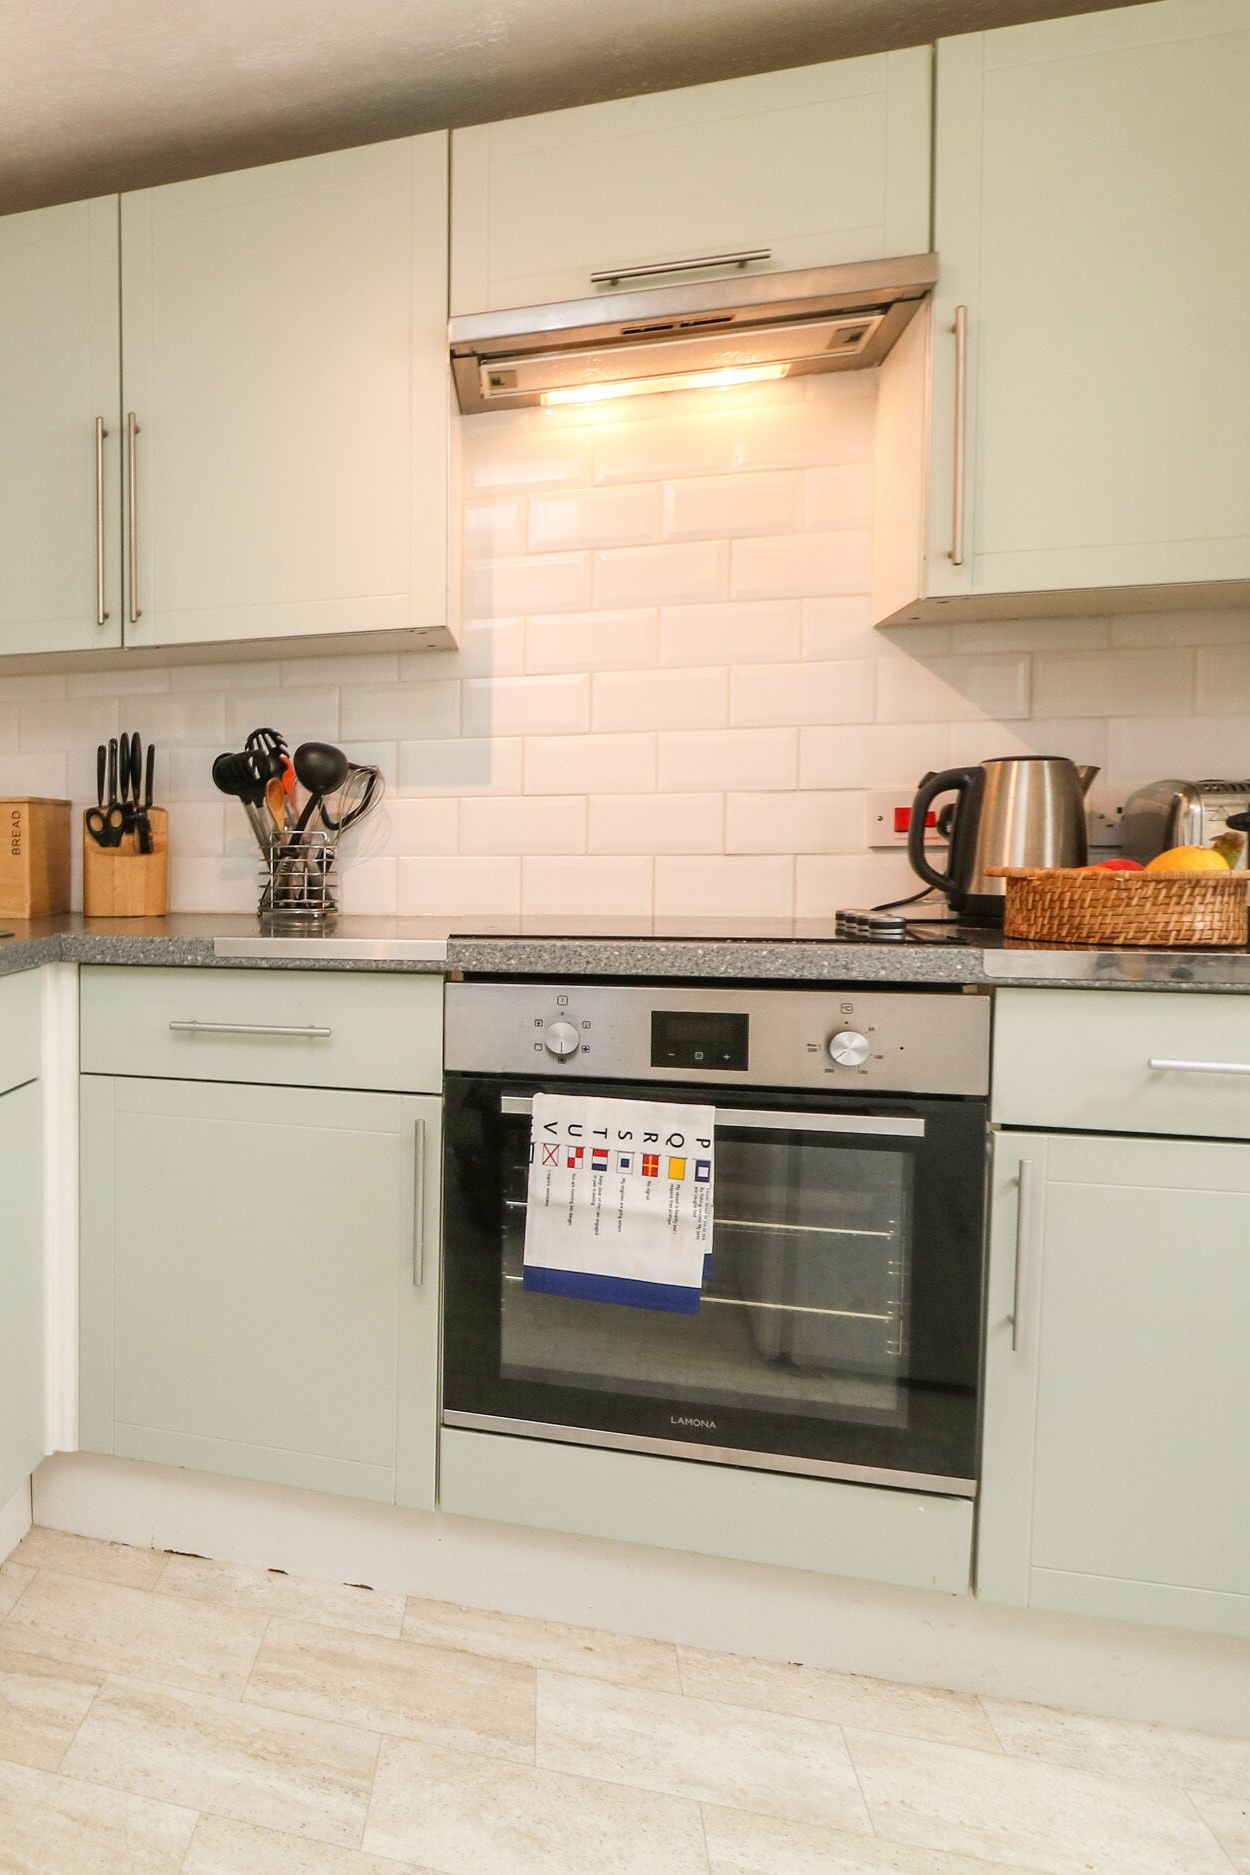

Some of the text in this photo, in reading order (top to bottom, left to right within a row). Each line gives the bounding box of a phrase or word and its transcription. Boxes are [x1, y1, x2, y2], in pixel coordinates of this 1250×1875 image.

[11, 810, 21, 855] BREAD
[543, 1121, 558, 1135] V
[567, 1124, 583, 1137] U
[593, 1128, 608, 1139] T
[618, 1130, 633, 1140] S
[643, 1132, 659, 1143] R
[666, 1132, 685, 1148] Q
[696, 1138, 711, 1148] P
[671, 1416, 717, 1429] LAMONA
